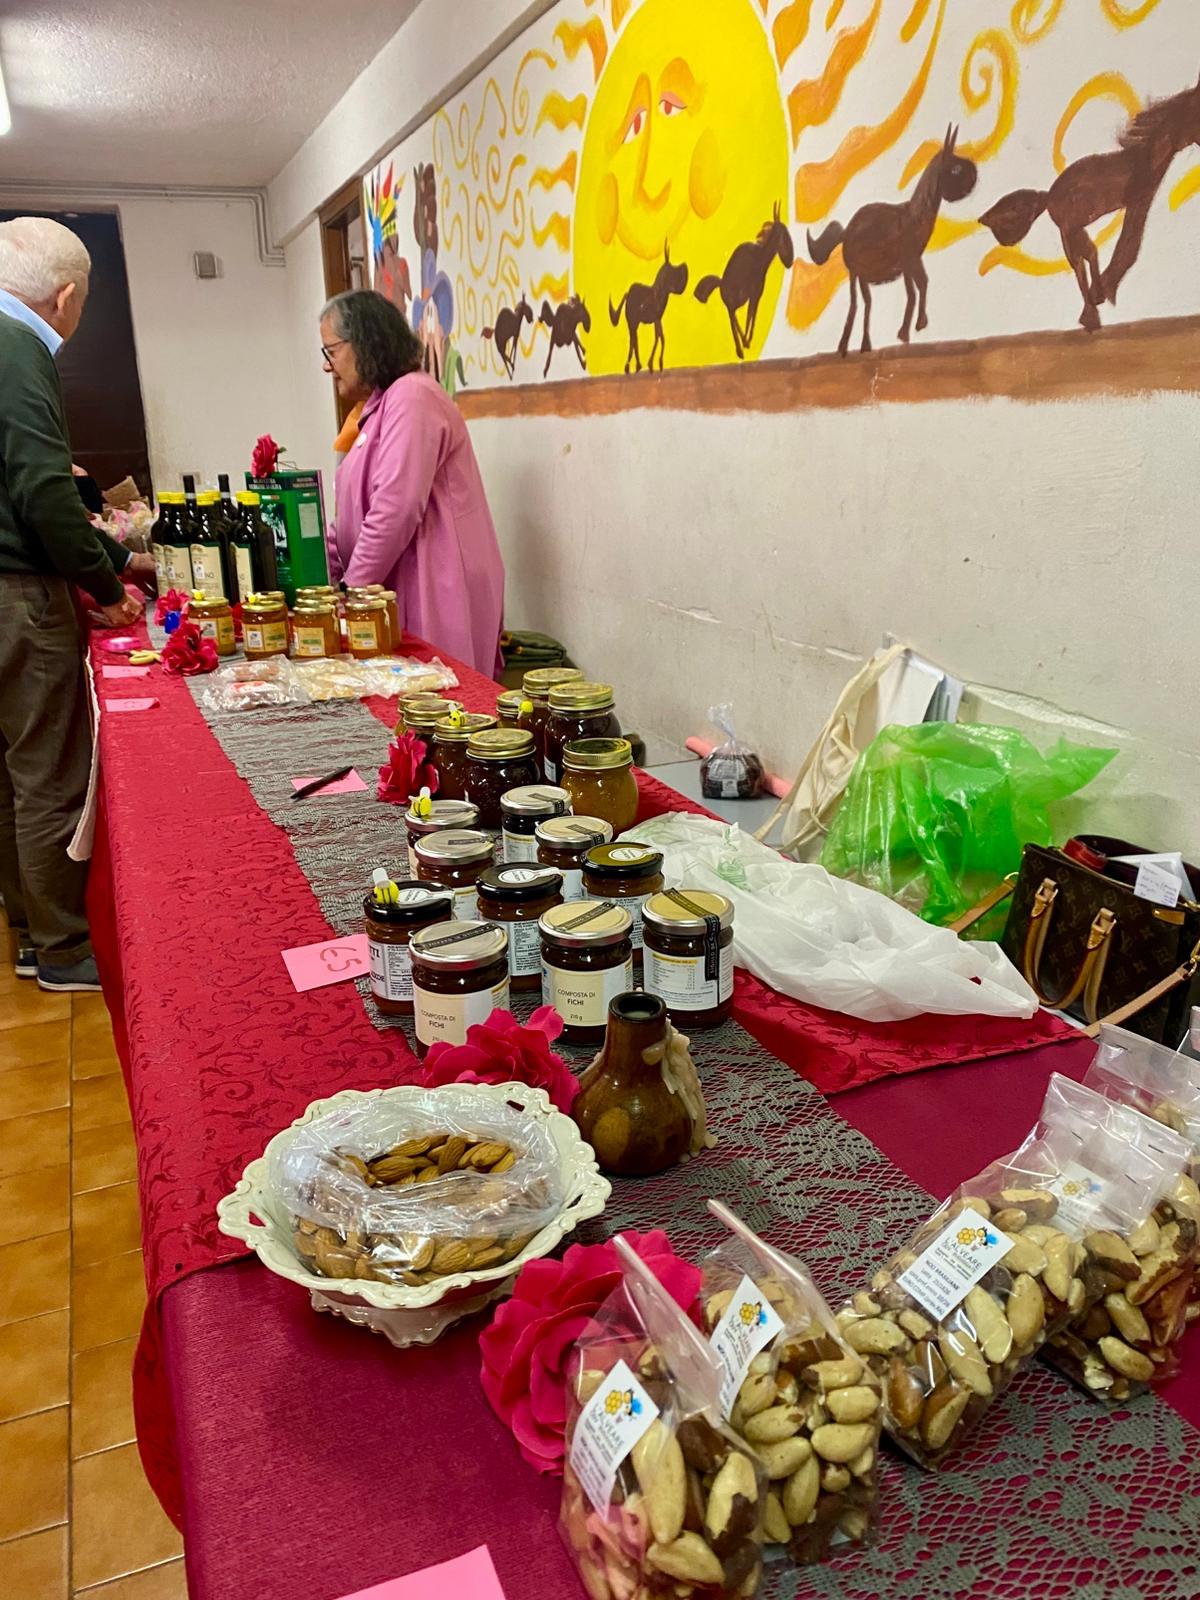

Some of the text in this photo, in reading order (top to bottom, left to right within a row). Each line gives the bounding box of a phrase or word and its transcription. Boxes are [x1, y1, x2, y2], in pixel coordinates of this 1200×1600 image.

[557, 988, 588, 998] COMPOSTA
[567, 998, 584, 1006] FICHI
[420, 1009, 448, 1021] COMPOSTA
[428, 1019, 445, 1029] FICHI
[943, 1236, 983, 1270] L'ALVEARE
